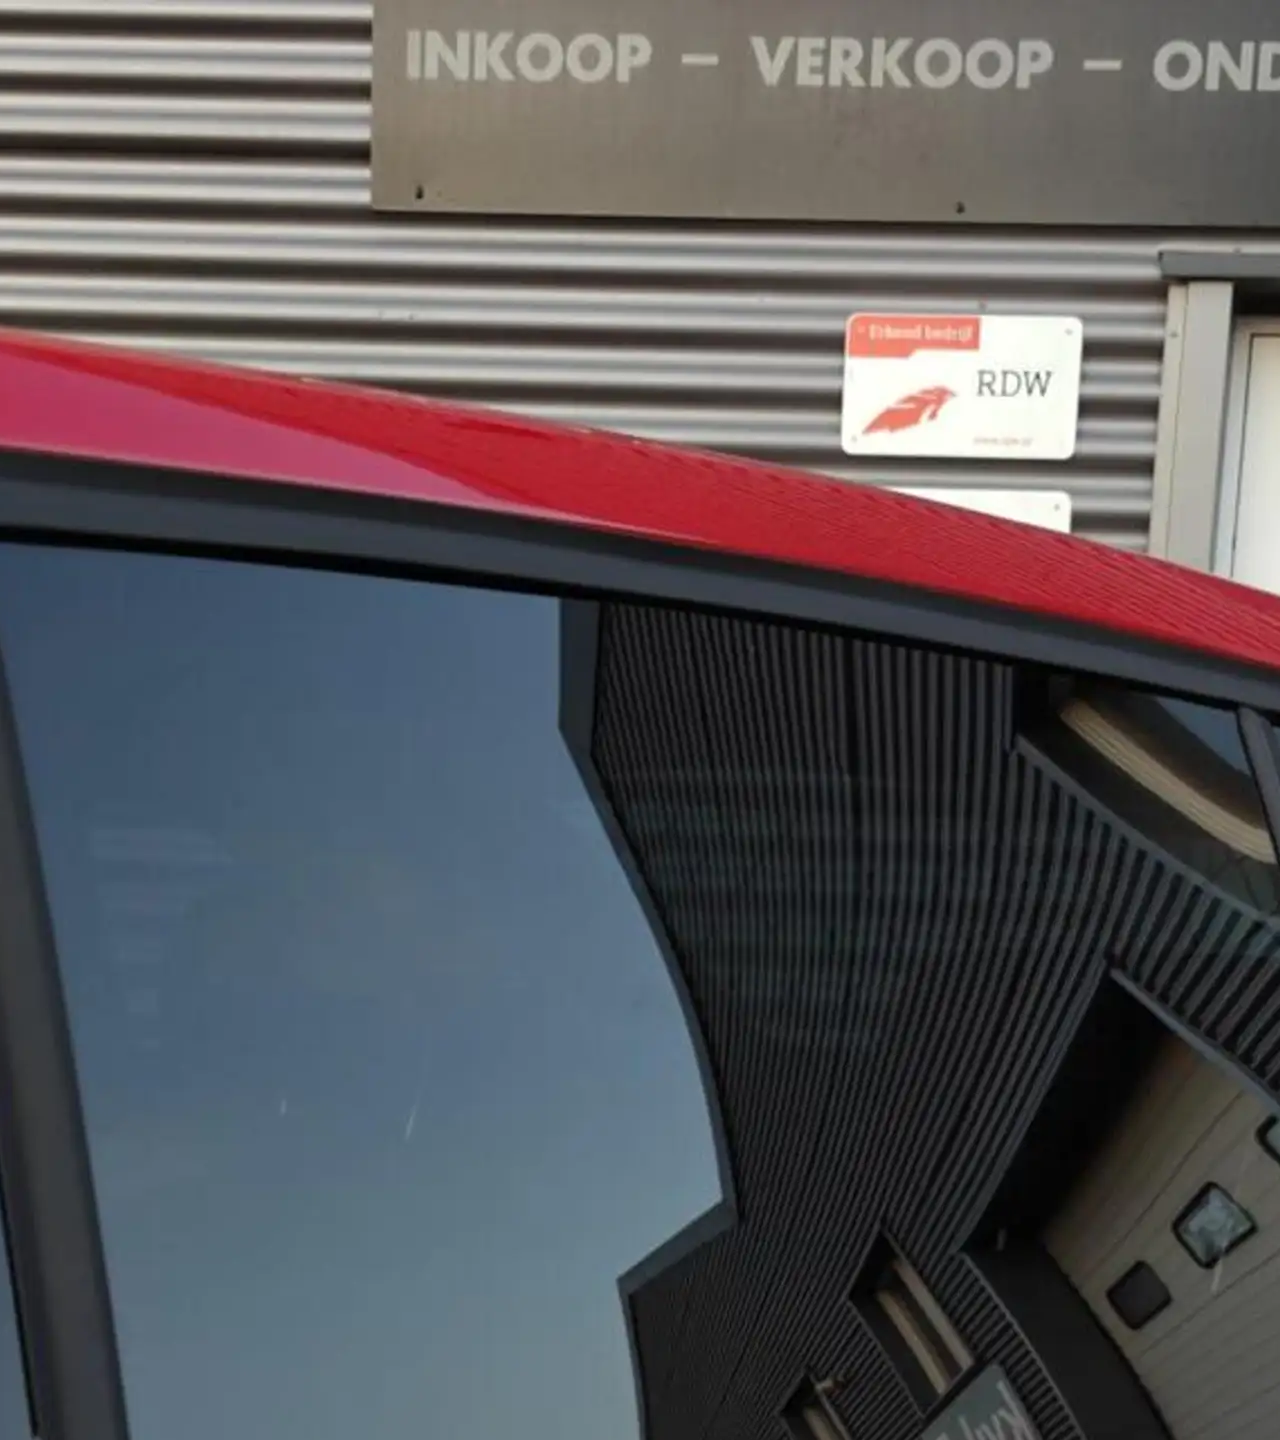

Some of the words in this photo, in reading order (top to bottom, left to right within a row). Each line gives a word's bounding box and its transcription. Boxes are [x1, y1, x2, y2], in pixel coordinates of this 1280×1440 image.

[407, 30, 654, 84] INKOOP
[751, 37, 1055, 90] VERKOOP
[976, 369, 1052, 398] RDW
